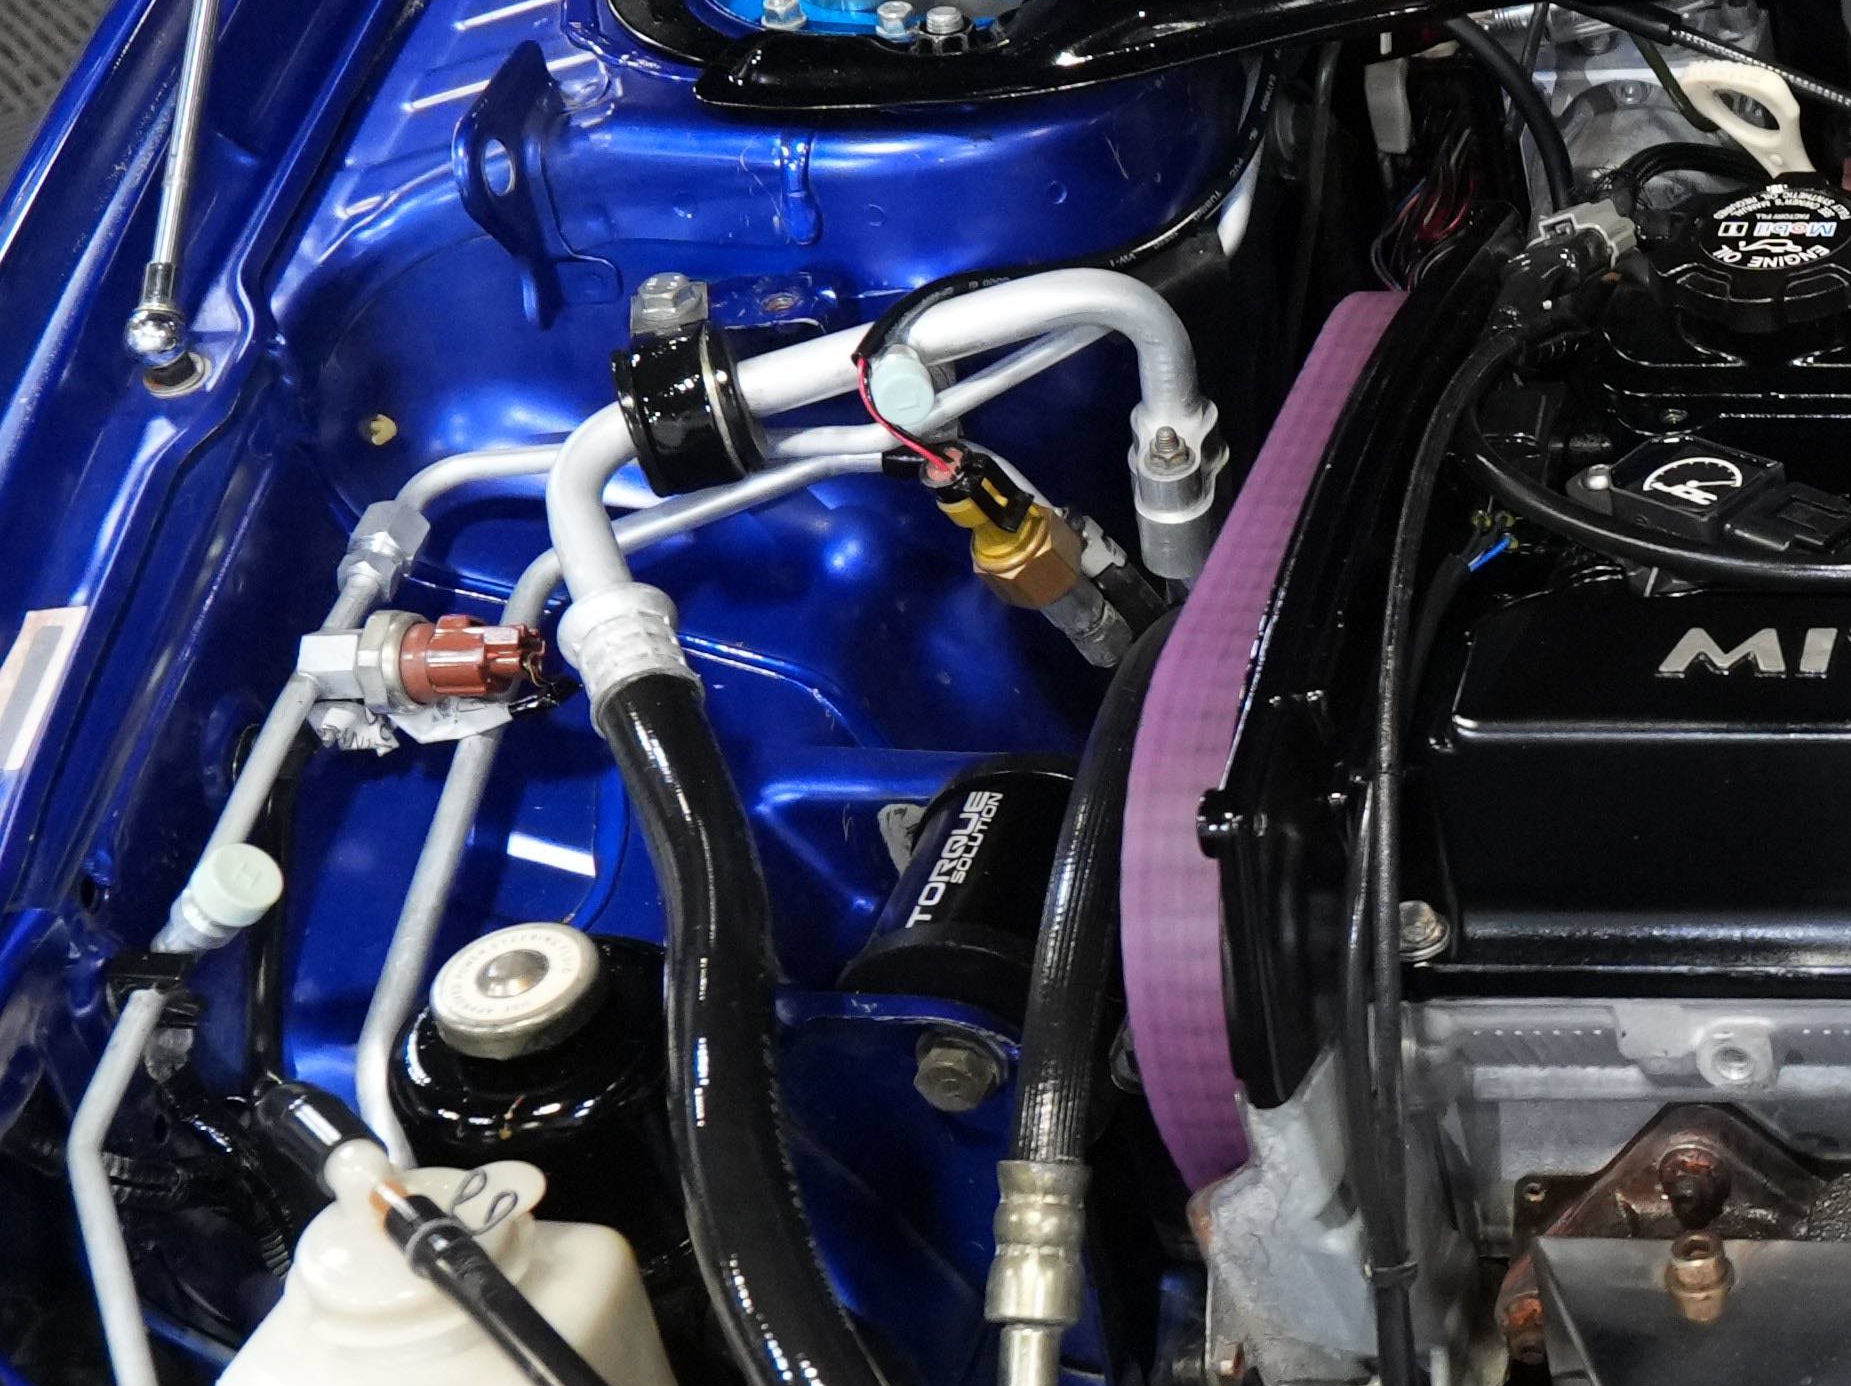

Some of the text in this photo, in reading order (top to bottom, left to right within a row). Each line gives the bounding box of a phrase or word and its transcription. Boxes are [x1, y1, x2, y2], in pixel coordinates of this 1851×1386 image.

[1713, 245, 1831, 268] ENGINE OIL
[1752, 221, 1837, 237] Mobil
[904, 791, 990, 929] TORQUE
[949, 792, 1004, 884] SOLUTION
